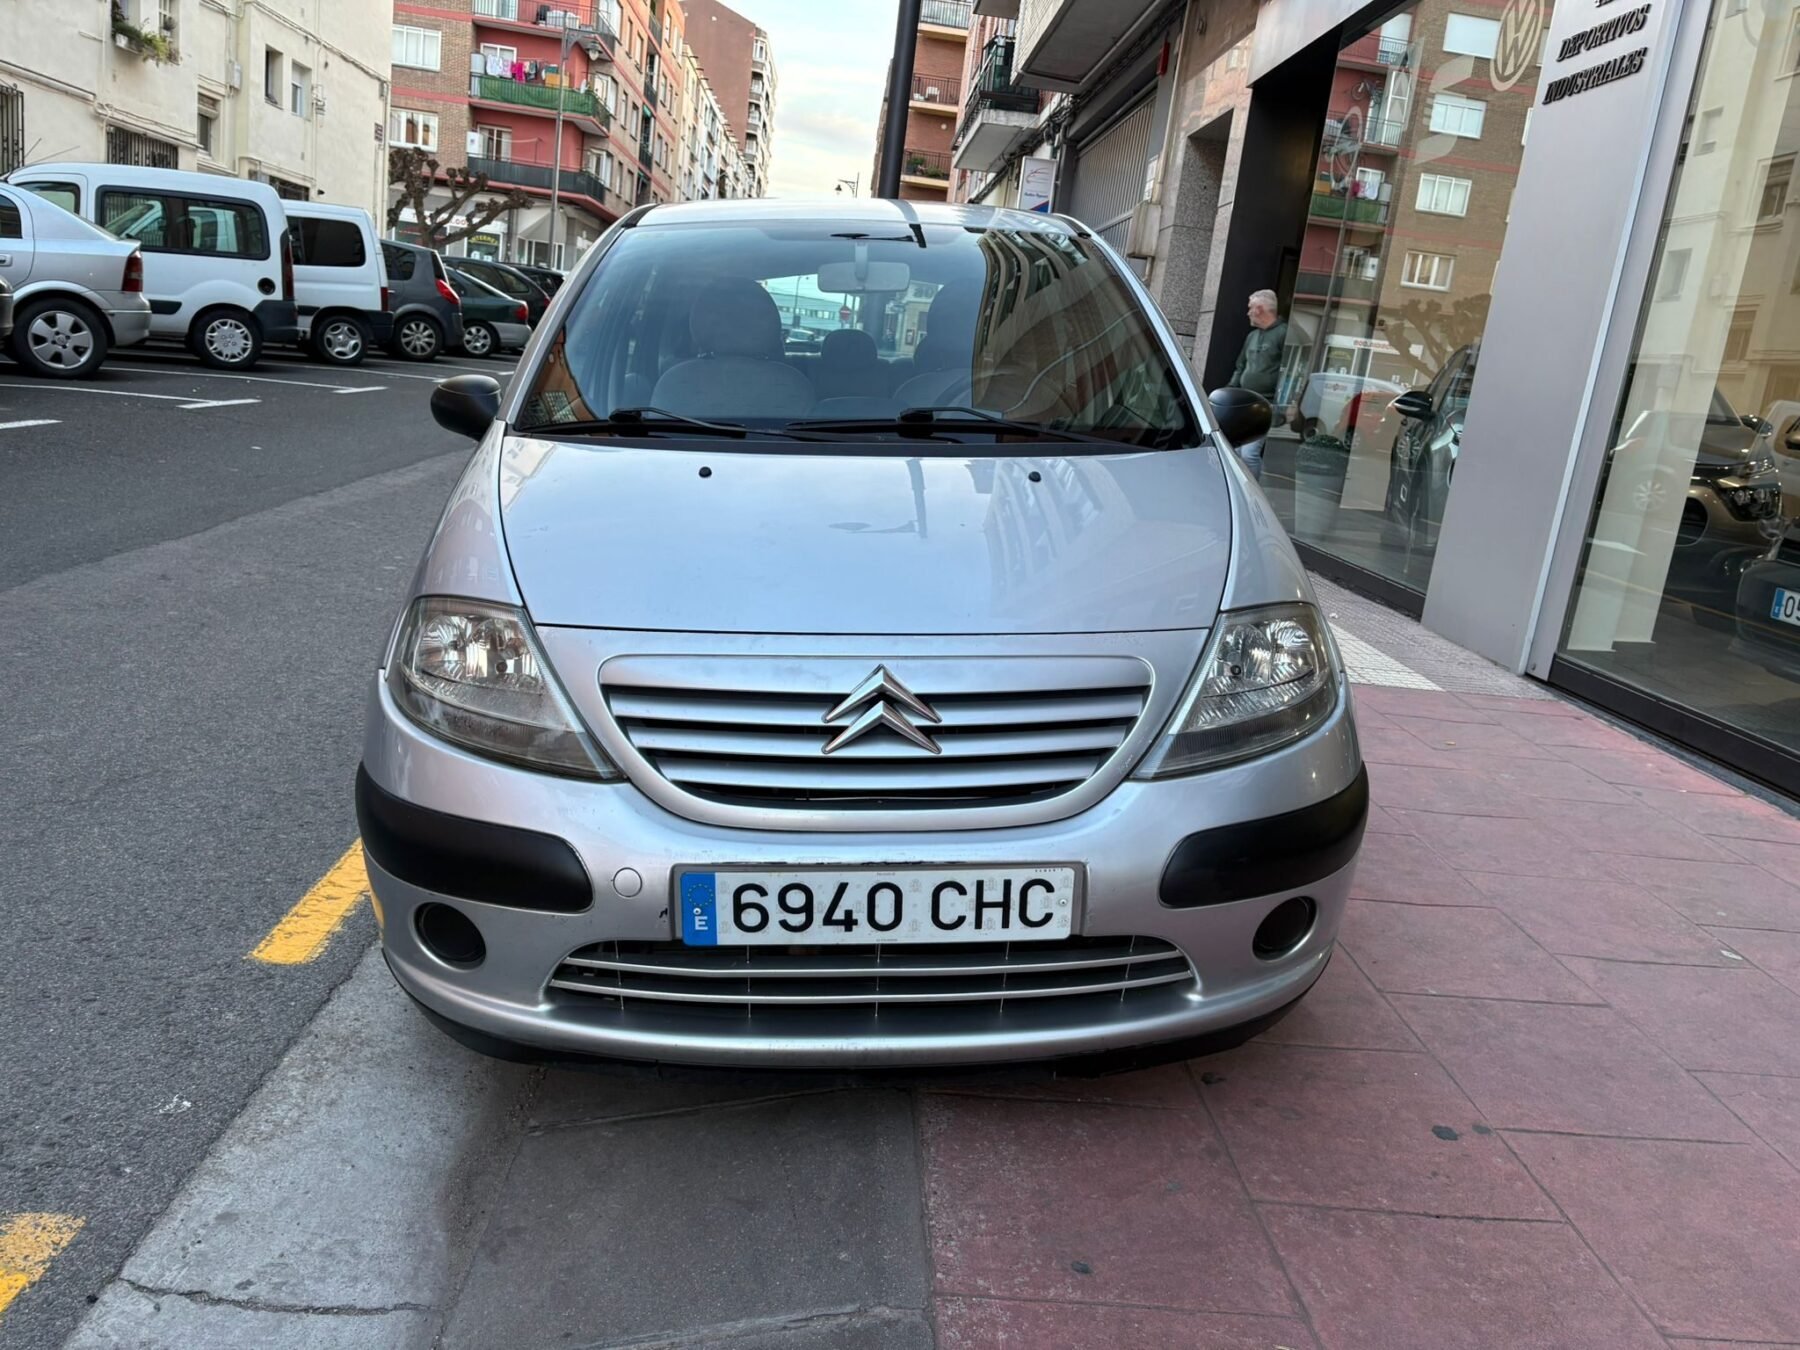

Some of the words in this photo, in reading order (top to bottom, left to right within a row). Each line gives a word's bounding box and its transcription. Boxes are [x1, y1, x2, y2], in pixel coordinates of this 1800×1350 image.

[1556, 3, 1652, 62] DEPORTIVOS
[1541, 47, 1649, 106] INDUSTRIALES
[694, 915, 708, 931] E
[732, 882, 904, 933] 6940
[931, 878, 1055, 930] CHC
